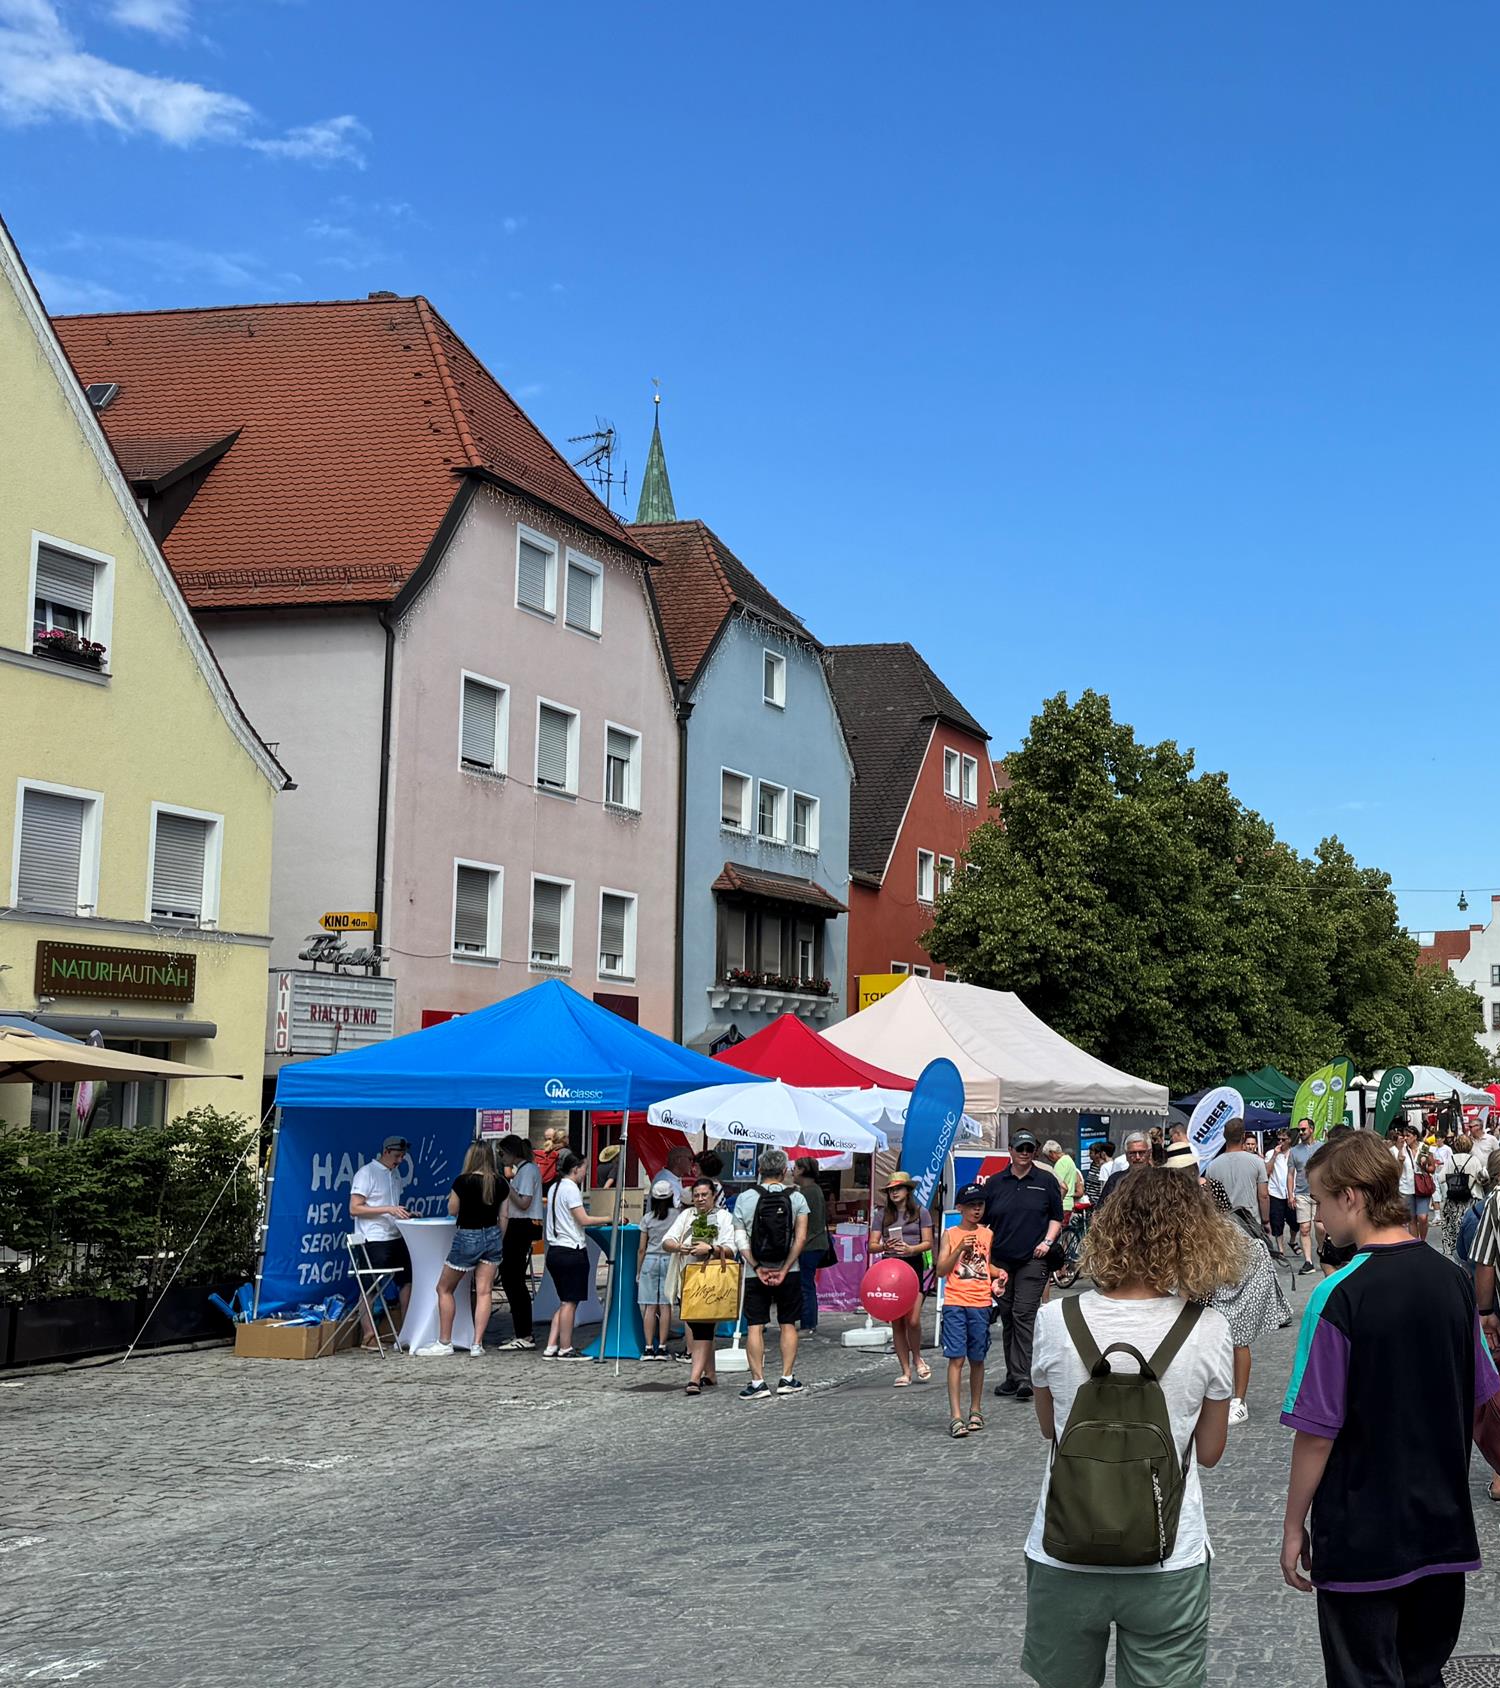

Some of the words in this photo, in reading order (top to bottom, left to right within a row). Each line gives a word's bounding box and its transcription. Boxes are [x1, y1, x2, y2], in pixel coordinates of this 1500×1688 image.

[324, 915, 349, 927] KINO
[51, 958, 188, 987] NATURHAUTNAH
[276, 974, 289, 1048] KINO
[310, 1004, 349, 1023] RIALTO
[353, 1007, 377, 1025] KINO
[570, 1089, 603, 1099] classic
[1381, 1083, 1398, 1112] AOK
[1193, 1100, 1229, 1144] HUBER
[749, 1128, 776, 1142] classic
[835, 1139, 857, 1150] classic
[930, 1111, 957, 1172] classic
[306, 1203, 343, 1225] HEY.
[298, 1260, 345, 1286] TACH
